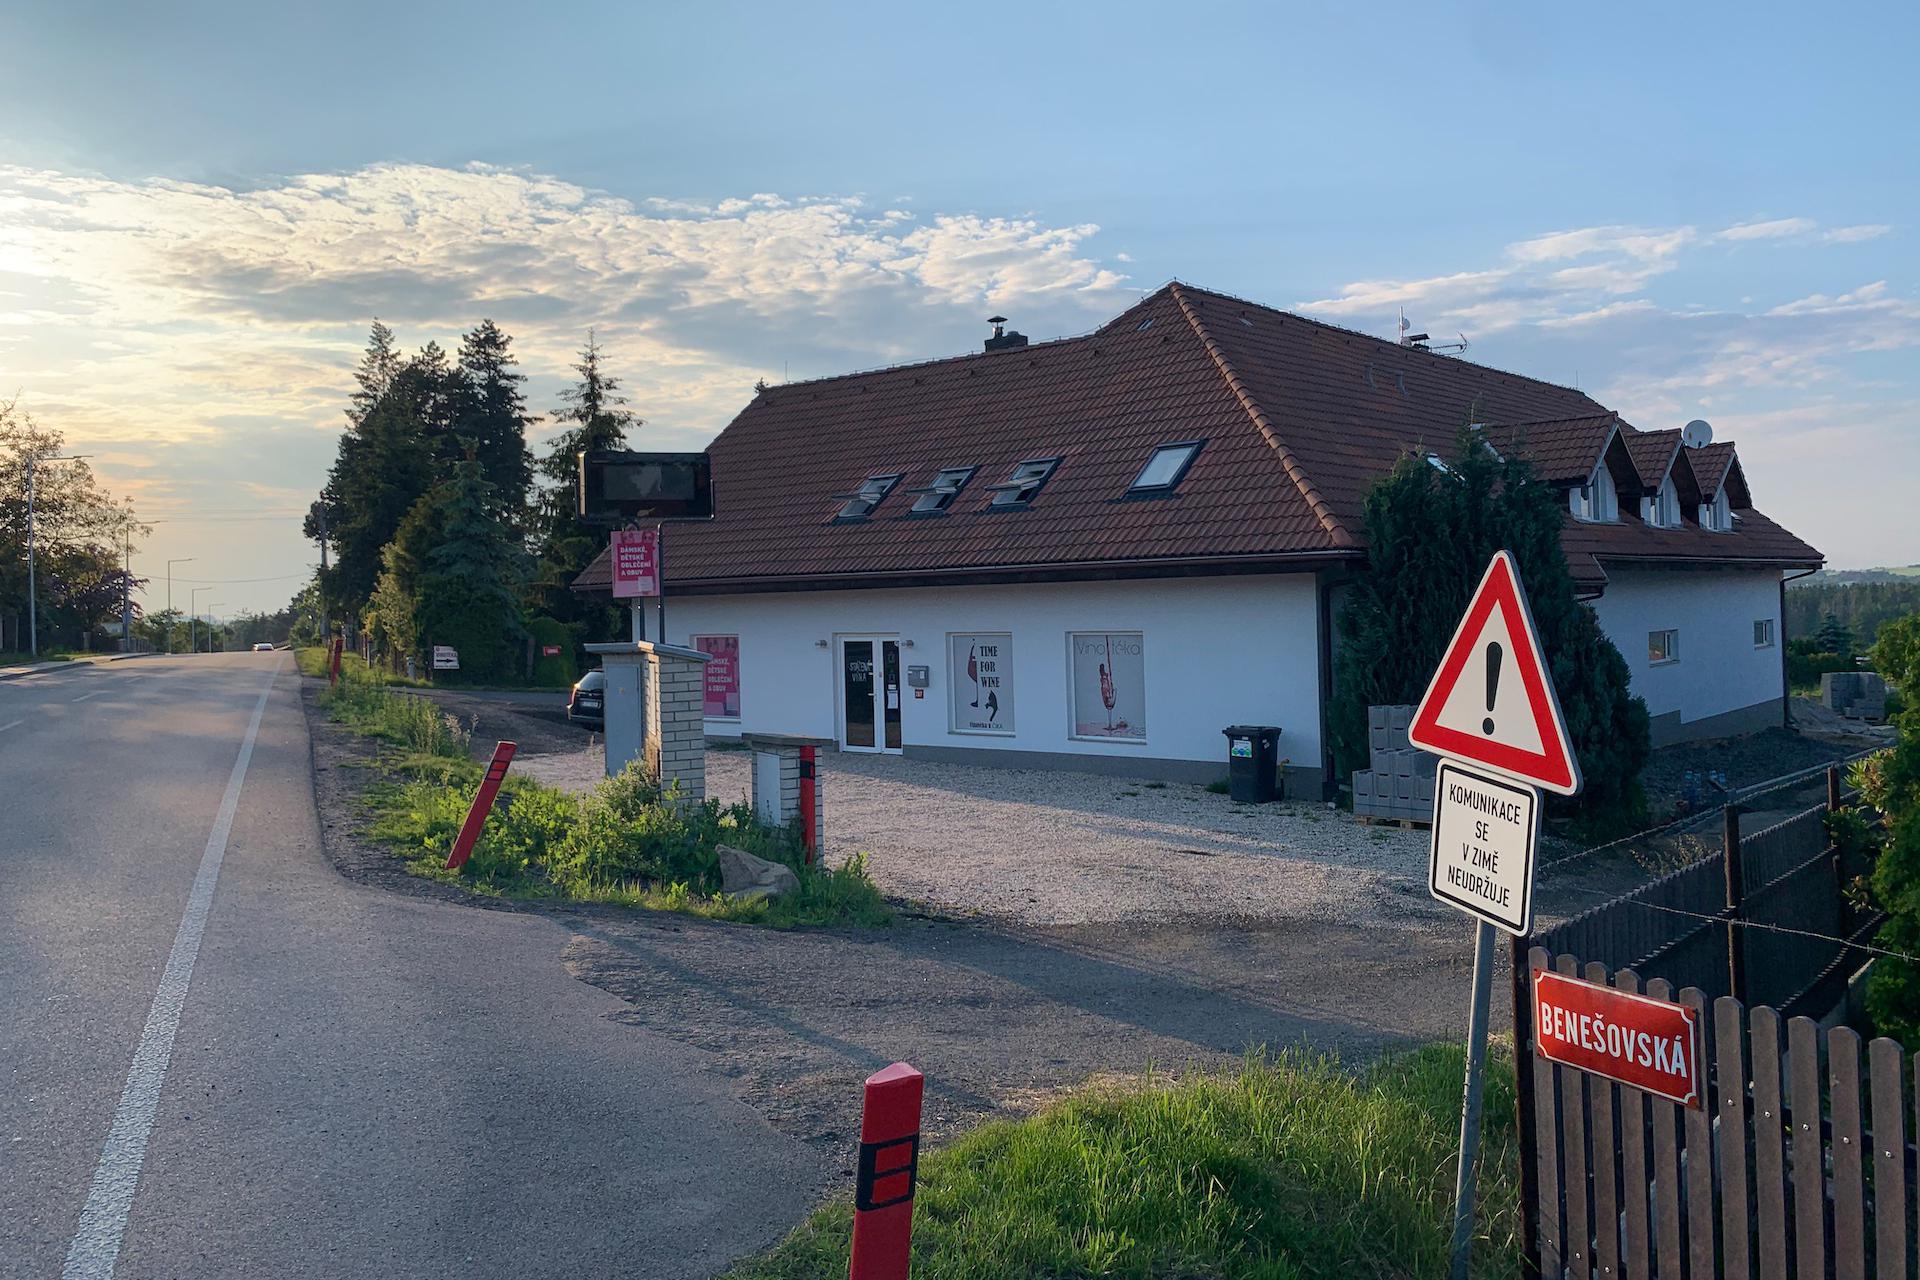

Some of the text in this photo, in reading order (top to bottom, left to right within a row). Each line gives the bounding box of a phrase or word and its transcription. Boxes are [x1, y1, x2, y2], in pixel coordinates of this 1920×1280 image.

[980, 646, 998, 657] TIME
[980, 661, 995, 672] FOR
[981, 676, 1000, 687] WINE
[1450, 784, 1521, 825] KOMUNIKACE
[1475, 821, 1489, 842] SE
[1462, 842, 1499, 874] V ZIMĚ
[1448, 865, 1510, 908] NEUDRŽUJE
[1541, 1002, 1687, 1078] BENEŠOVSKÁ
